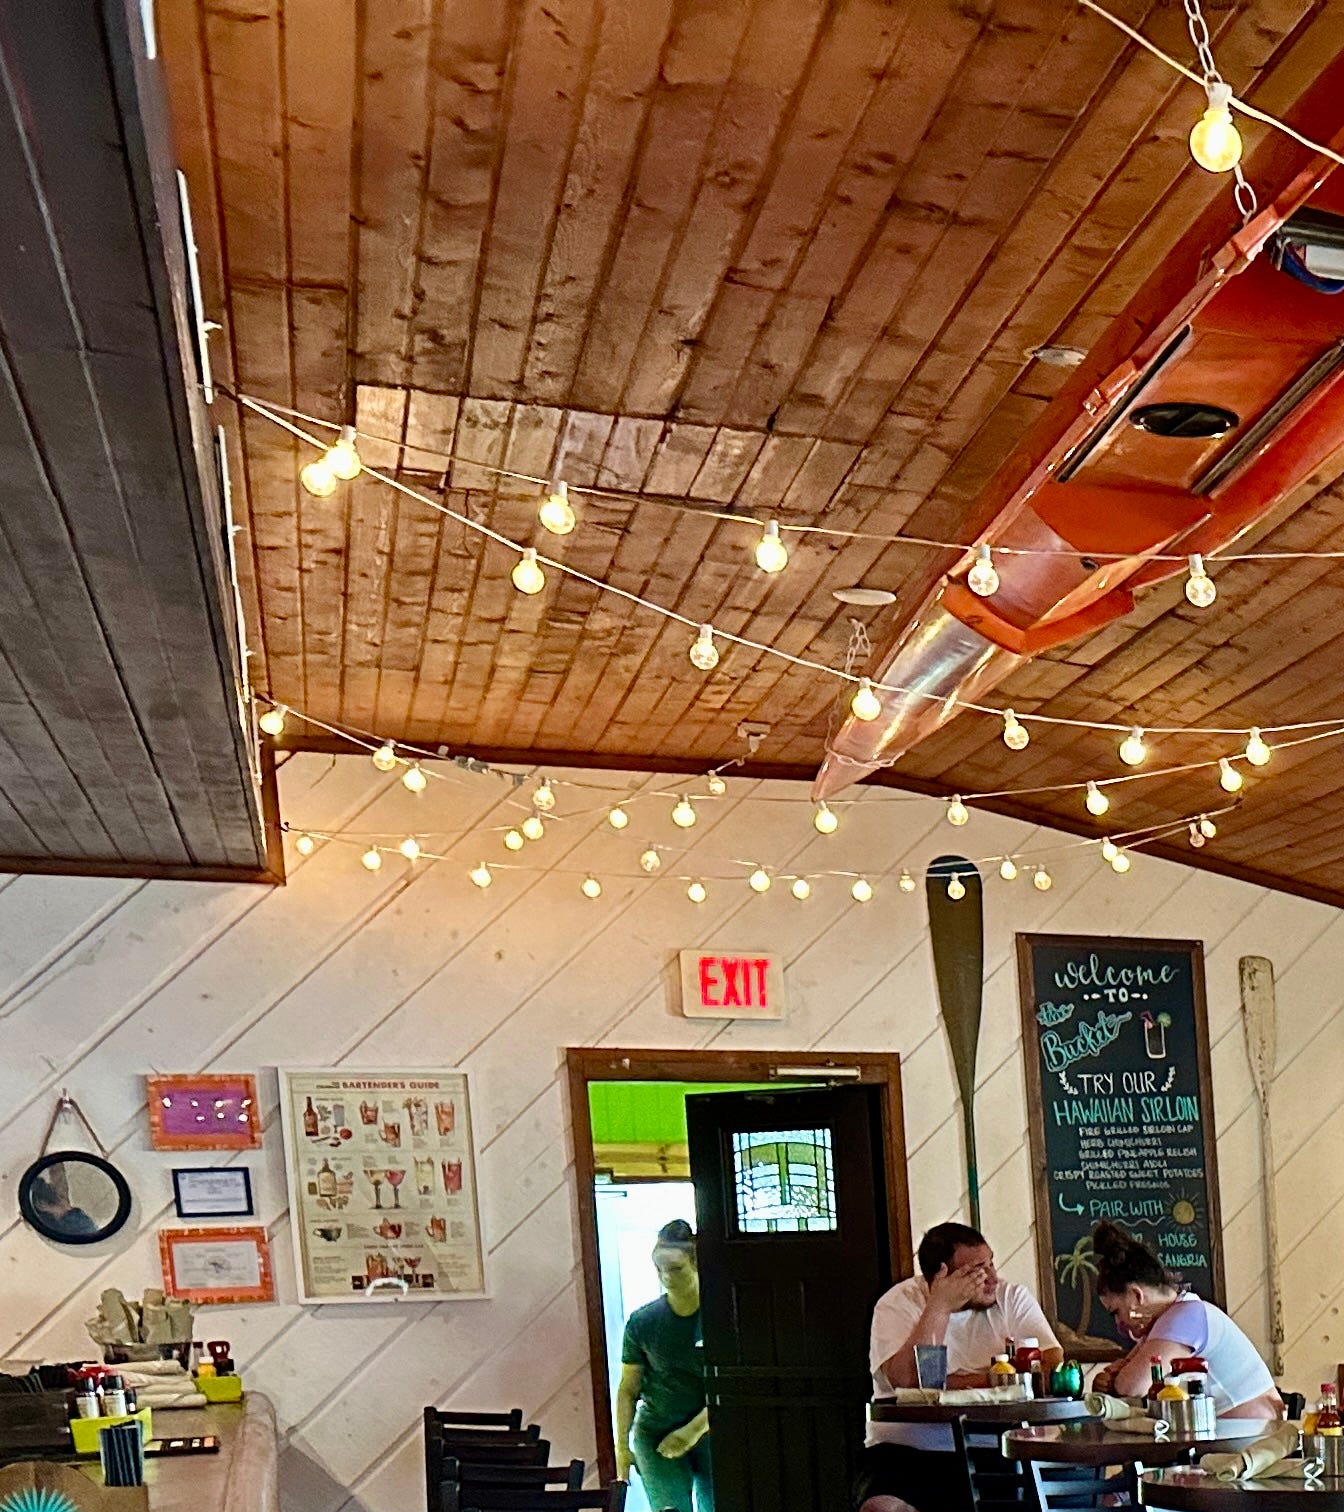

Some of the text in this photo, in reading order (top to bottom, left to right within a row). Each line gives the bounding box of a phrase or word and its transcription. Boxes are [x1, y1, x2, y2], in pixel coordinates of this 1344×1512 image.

[1054, 953, 1180, 989] welcome
[698, 956, 771, 1008] EXIT
[1103, 987, 1129, 1003] TO
[1041, 1010, 1133, 1073] Bucket
[342, 1081, 406, 1089] BARTENDER'S
[409, 1081, 439, 1089] GUIDE
[1077, 1071, 1157, 1095] TRY OUR
[1053, 1095, 1200, 1126] HAWAIIAN SIRLOIN
[1079, 1126, 1100, 1137] FIRE
[1088, 1169, 1127, 1180] ROASTED
[1090, 1199, 1164, 1217] PAIR WITH
[1158, 1233, 1198, 1248] HOUSE
[1156, 1253, 1208, 1268] SANGRIA
